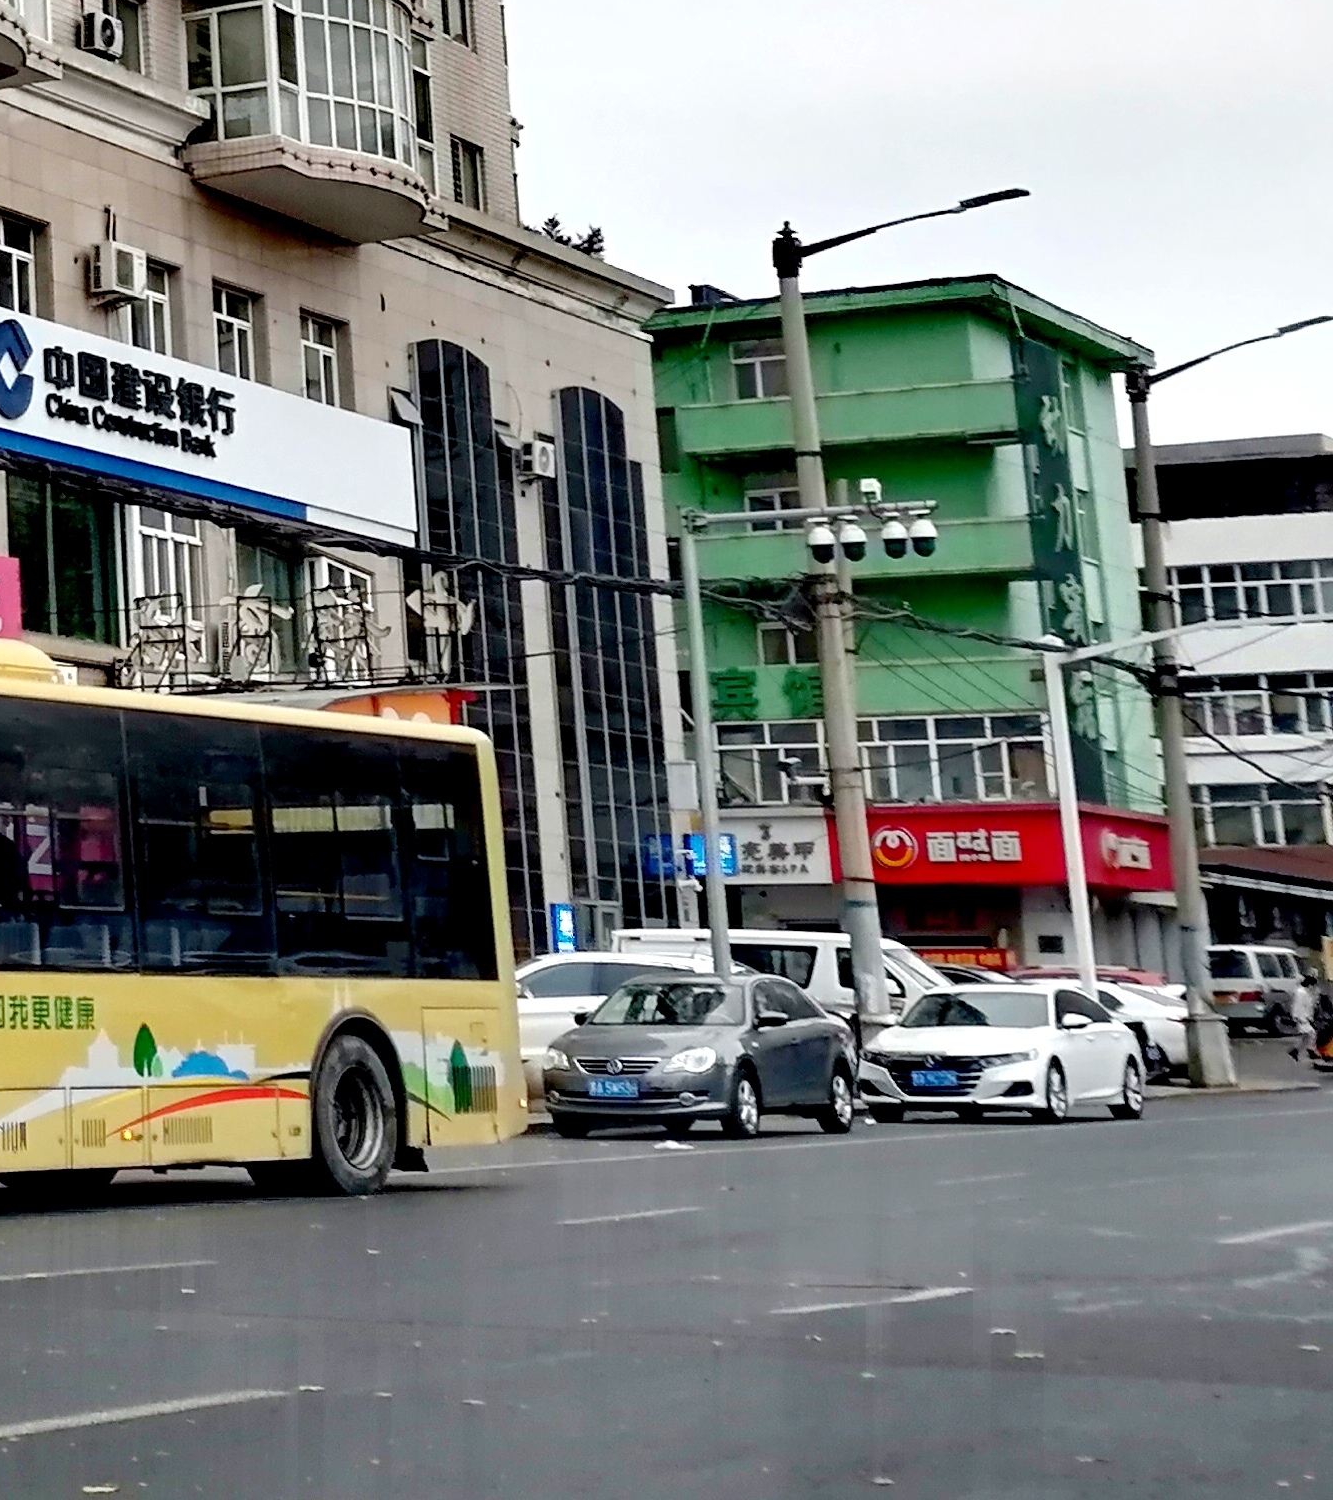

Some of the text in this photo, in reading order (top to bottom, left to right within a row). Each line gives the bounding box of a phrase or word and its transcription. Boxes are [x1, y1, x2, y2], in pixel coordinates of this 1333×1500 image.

[43, 346, 235, 435] 中国建设银行
[45, 393, 217, 458] China Construction Bank
